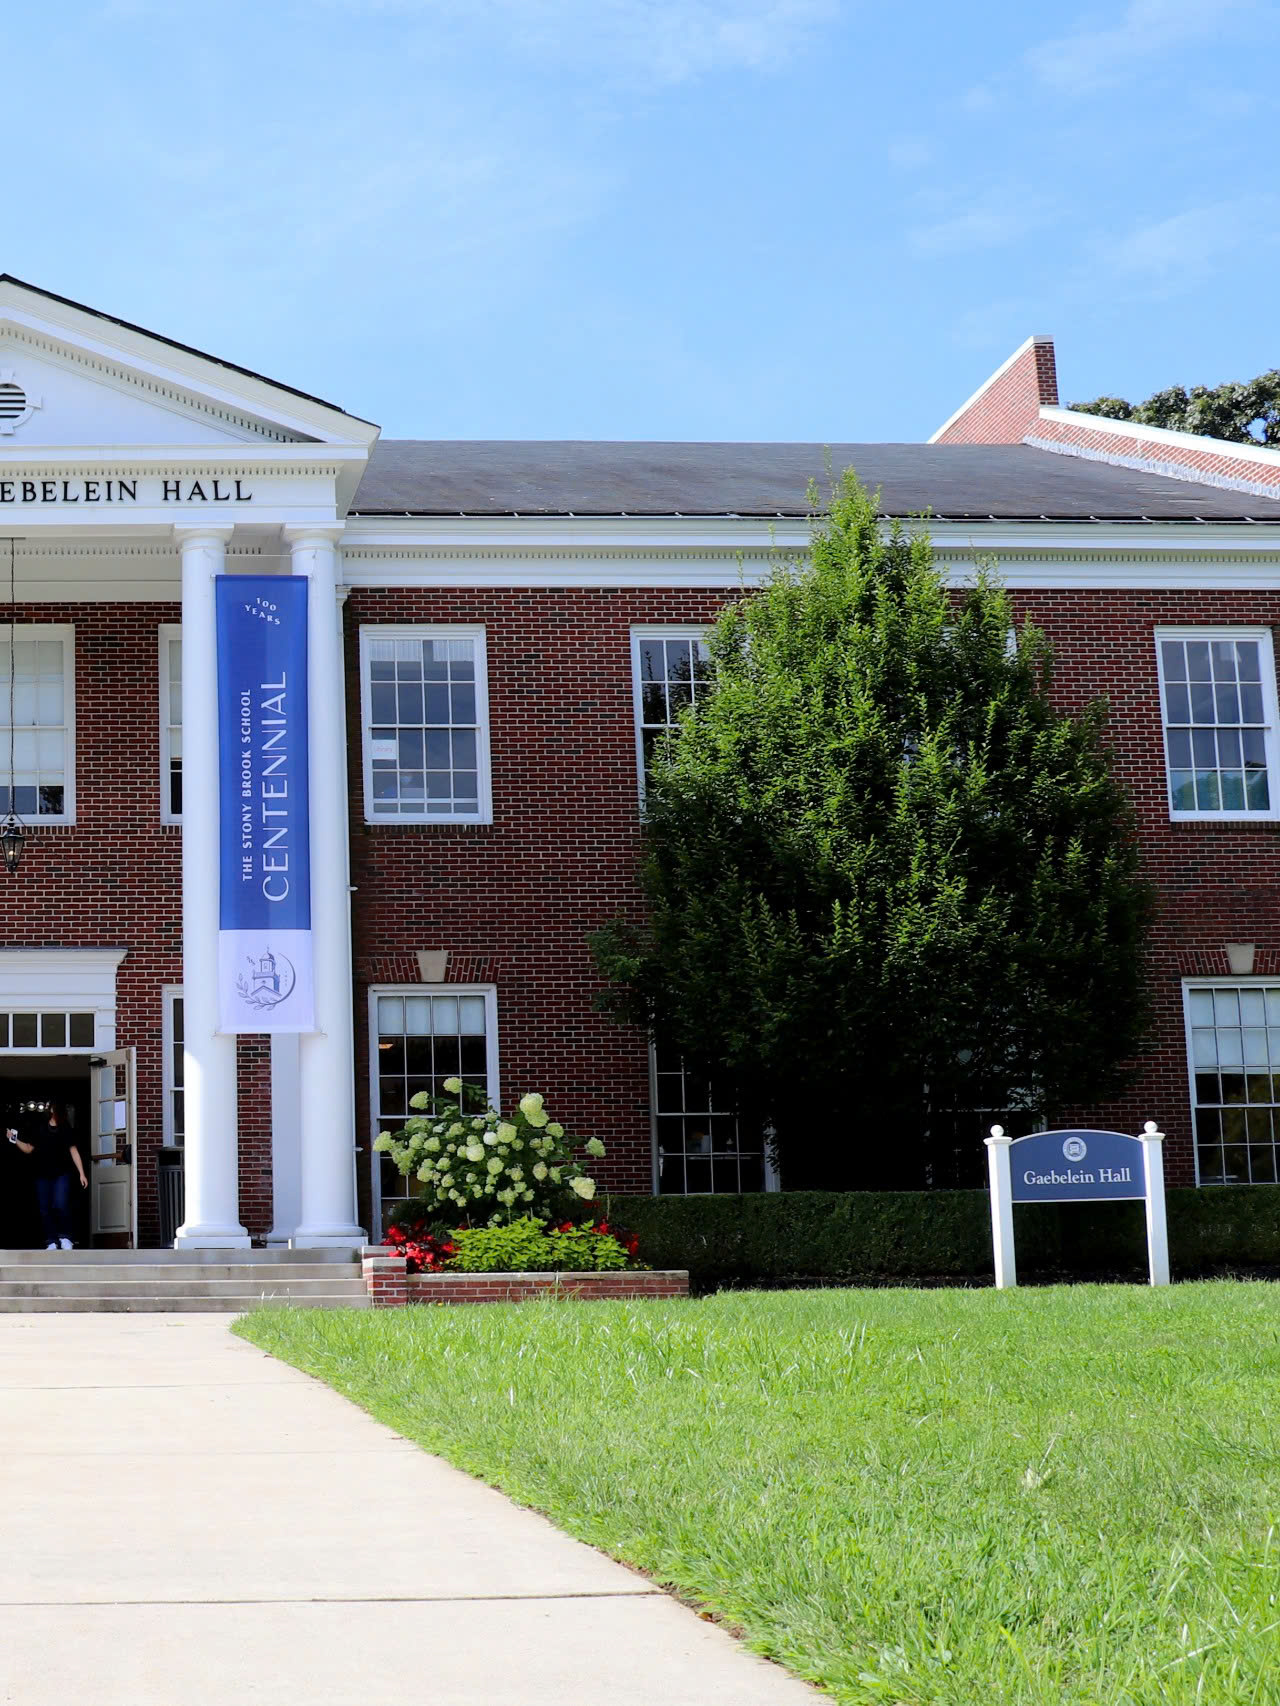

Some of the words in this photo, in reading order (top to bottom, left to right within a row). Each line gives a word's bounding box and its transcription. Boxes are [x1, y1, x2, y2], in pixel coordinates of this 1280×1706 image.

[162, 479, 253, 501] HALL
[244, 604, 281, 625] YEARS
[256, 597, 277, 611] 100
[240, 689, 252, 744] SCHOOL
[241, 750, 252, 797] BROOK
[261, 671, 288, 902] CENTENNIAL
[242, 803, 253, 849] STONY
[242, 855, 253, 882] THE
[1023, 1169, 1095, 1185] Gaebelein
[1098, 1167, 1132, 1183] Hall
